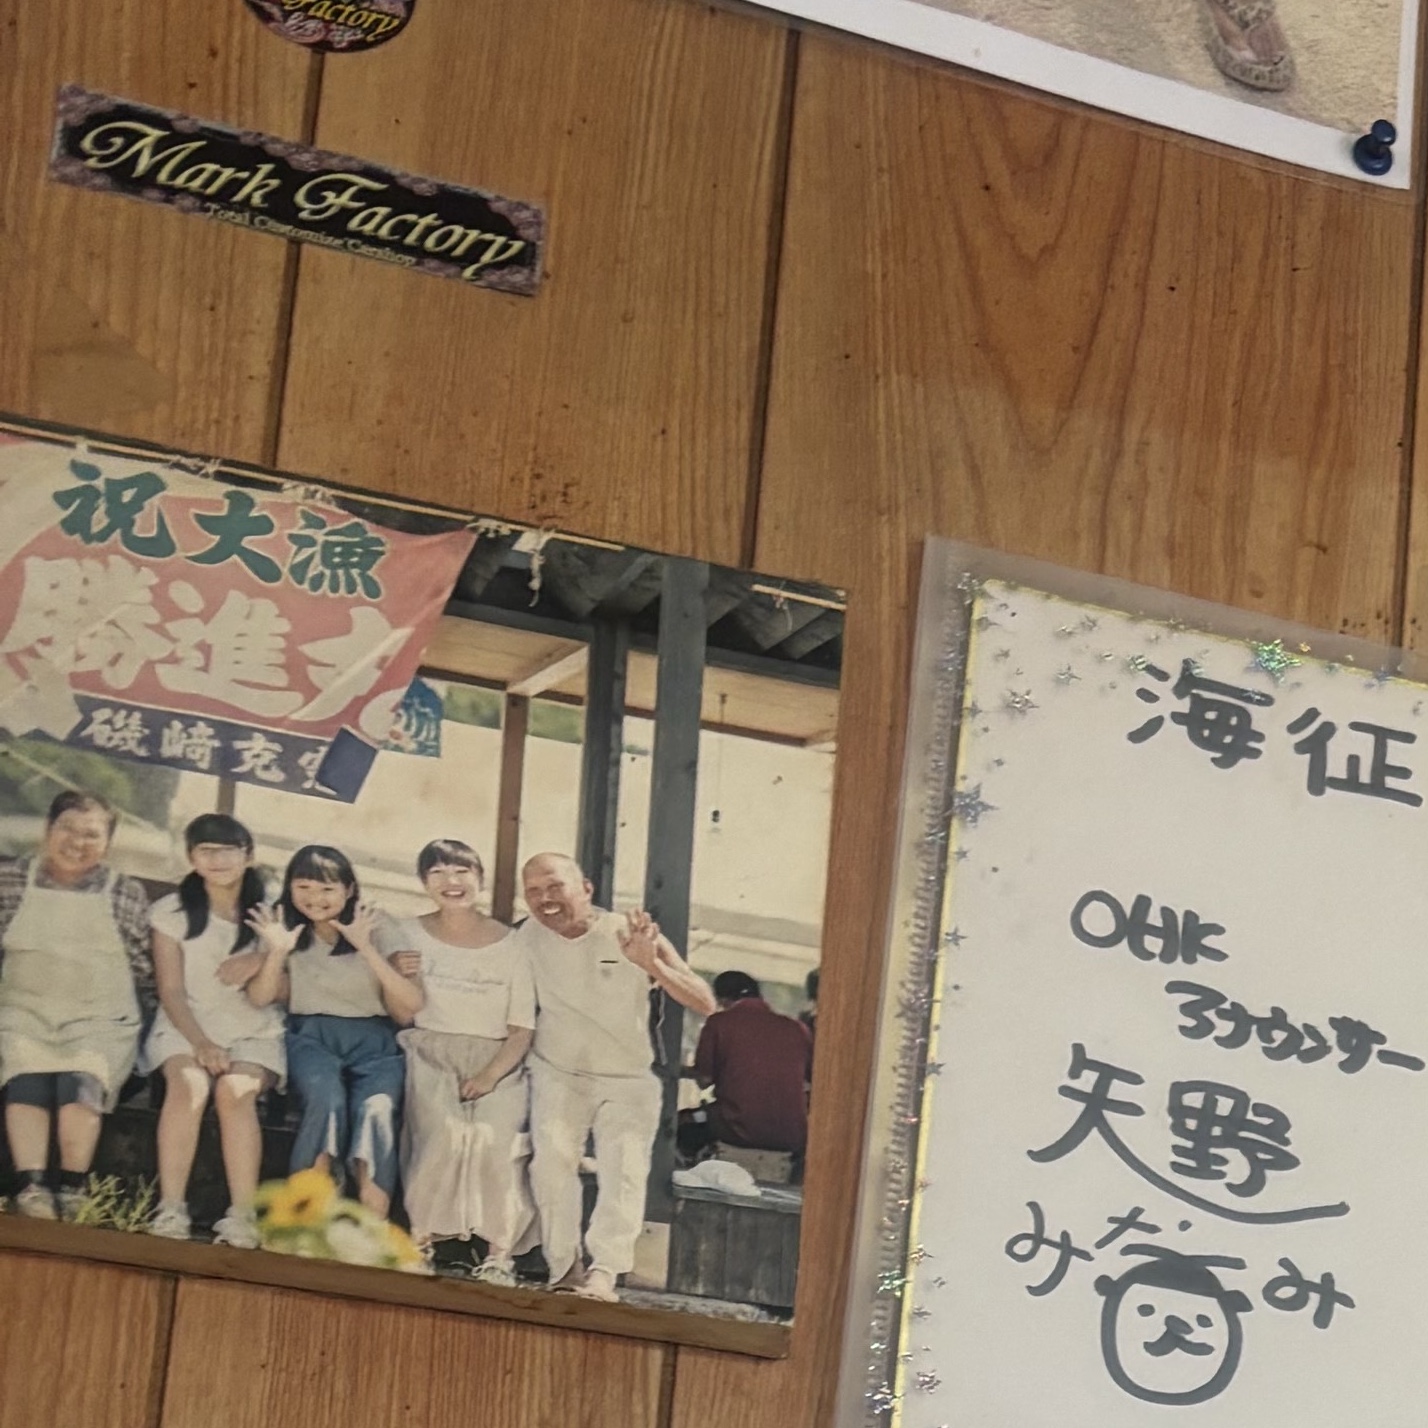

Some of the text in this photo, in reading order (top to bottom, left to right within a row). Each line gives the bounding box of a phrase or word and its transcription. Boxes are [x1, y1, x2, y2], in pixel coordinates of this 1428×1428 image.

[79, 121, 525, 280] Mark Factory
[53, 459, 388, 600] 祝大漁
[1071, 889, 1230, 964] OHK
[1026, 1042, 1351, 1225] 矢野
